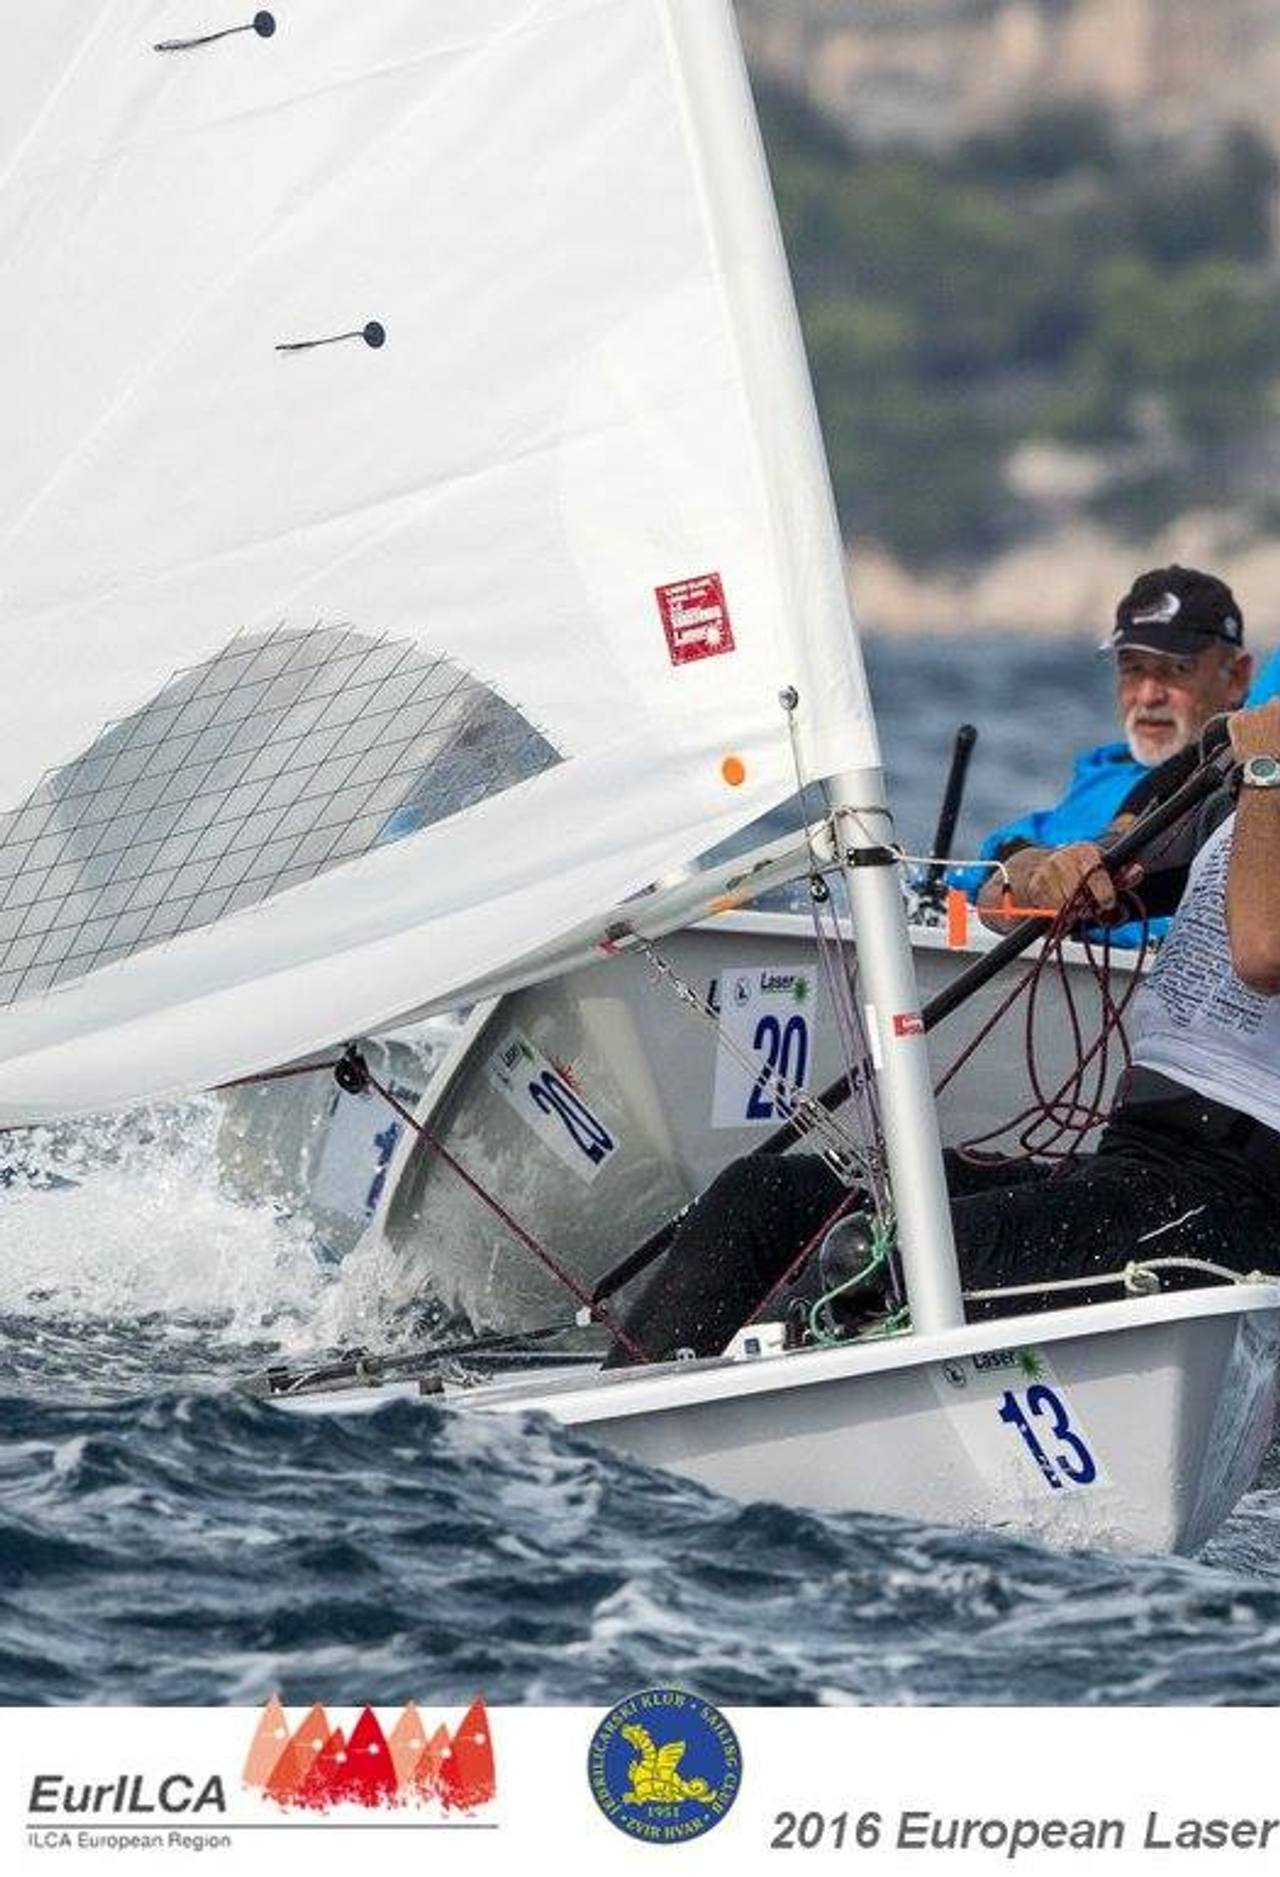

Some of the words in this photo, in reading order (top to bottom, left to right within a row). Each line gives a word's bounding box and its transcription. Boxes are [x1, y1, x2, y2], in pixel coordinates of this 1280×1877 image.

[760, 971, 794, 990] Laser
[746, 1014, 807, 1120] 20
[528, 1070, 614, 1165] 20
[999, 1384, 1096, 1489] 13
